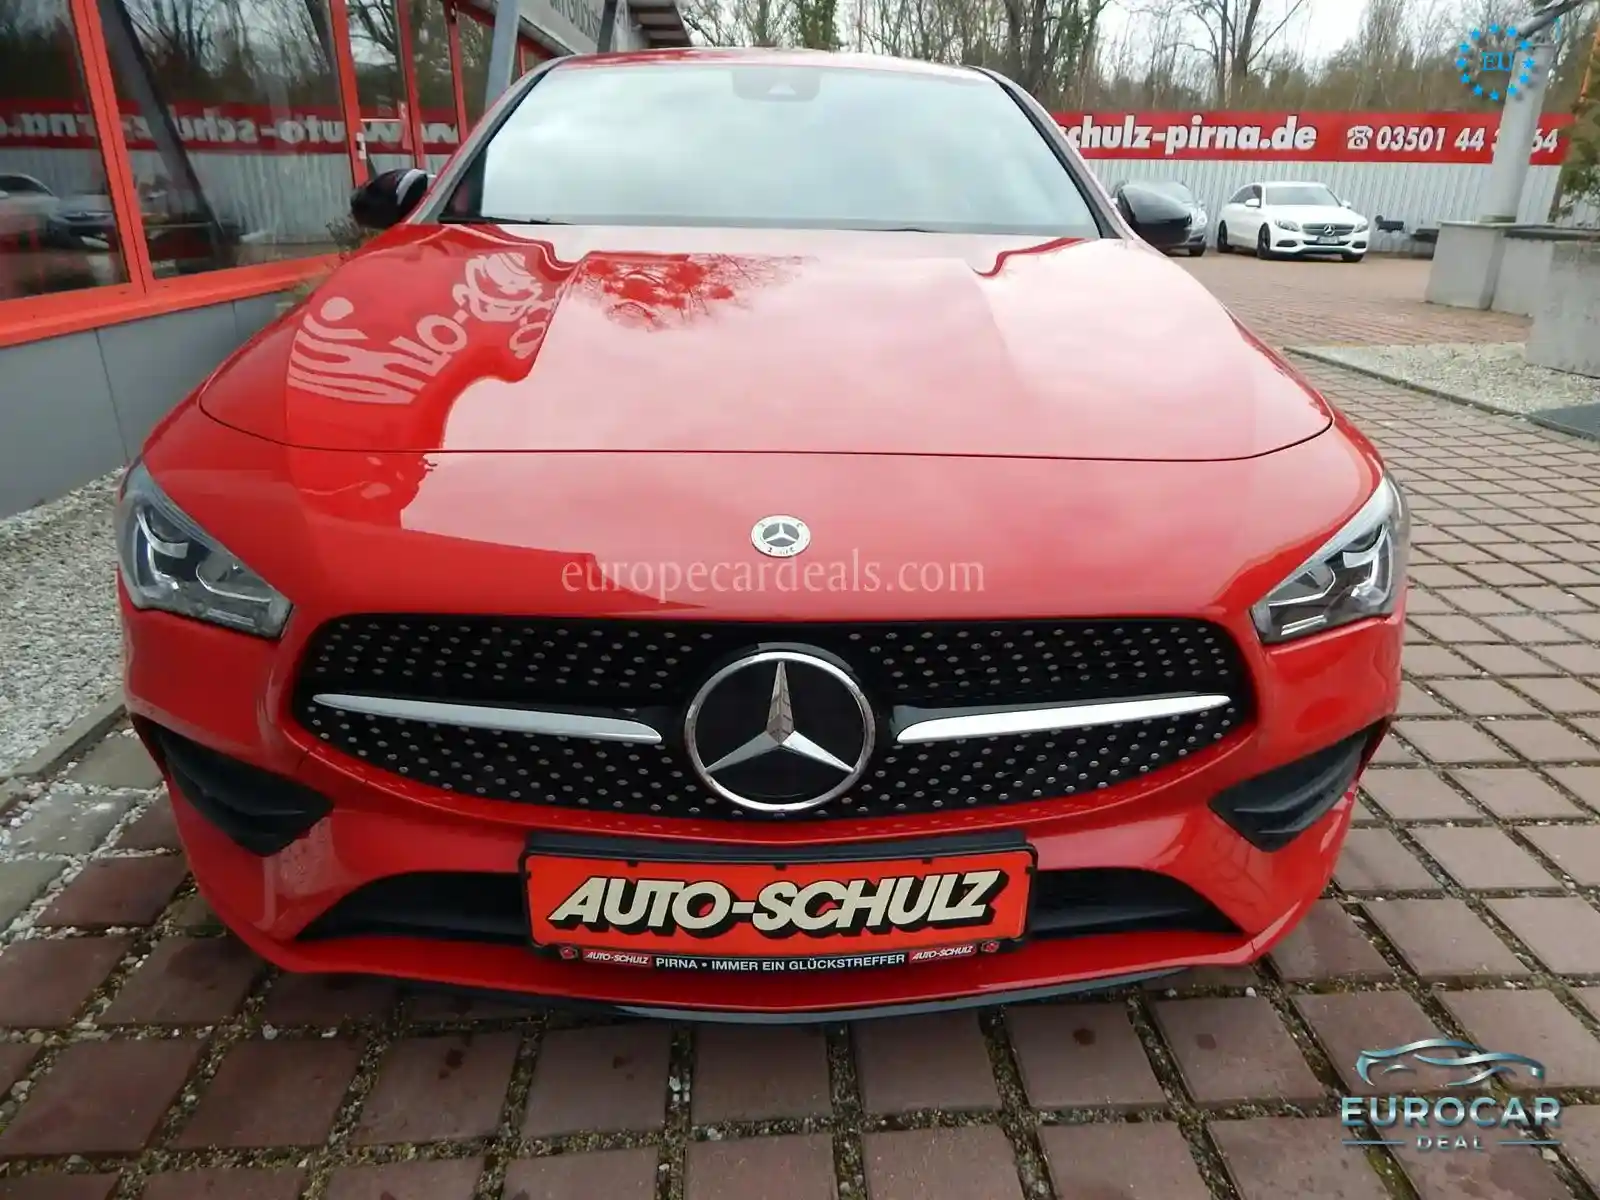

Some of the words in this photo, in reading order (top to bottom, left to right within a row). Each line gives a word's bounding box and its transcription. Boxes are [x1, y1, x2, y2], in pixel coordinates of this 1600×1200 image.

[1376, 125, 1446, 151] 03501
[1454, 127, 1485, 152] 44
[548, 869, 1005, 935] AUTO-SCHULZ
[586, 951, 649, 965] AUTO-SCHULZ
[656, 957, 698, 969] PIRNA
[711, 960, 758, 971] IMMER
[762, 961, 785, 971] EIN
[789, 954, 905, 971] GLÜCKSTREFFER
[911, 945, 974, 961] AUTO-SCHULZ
